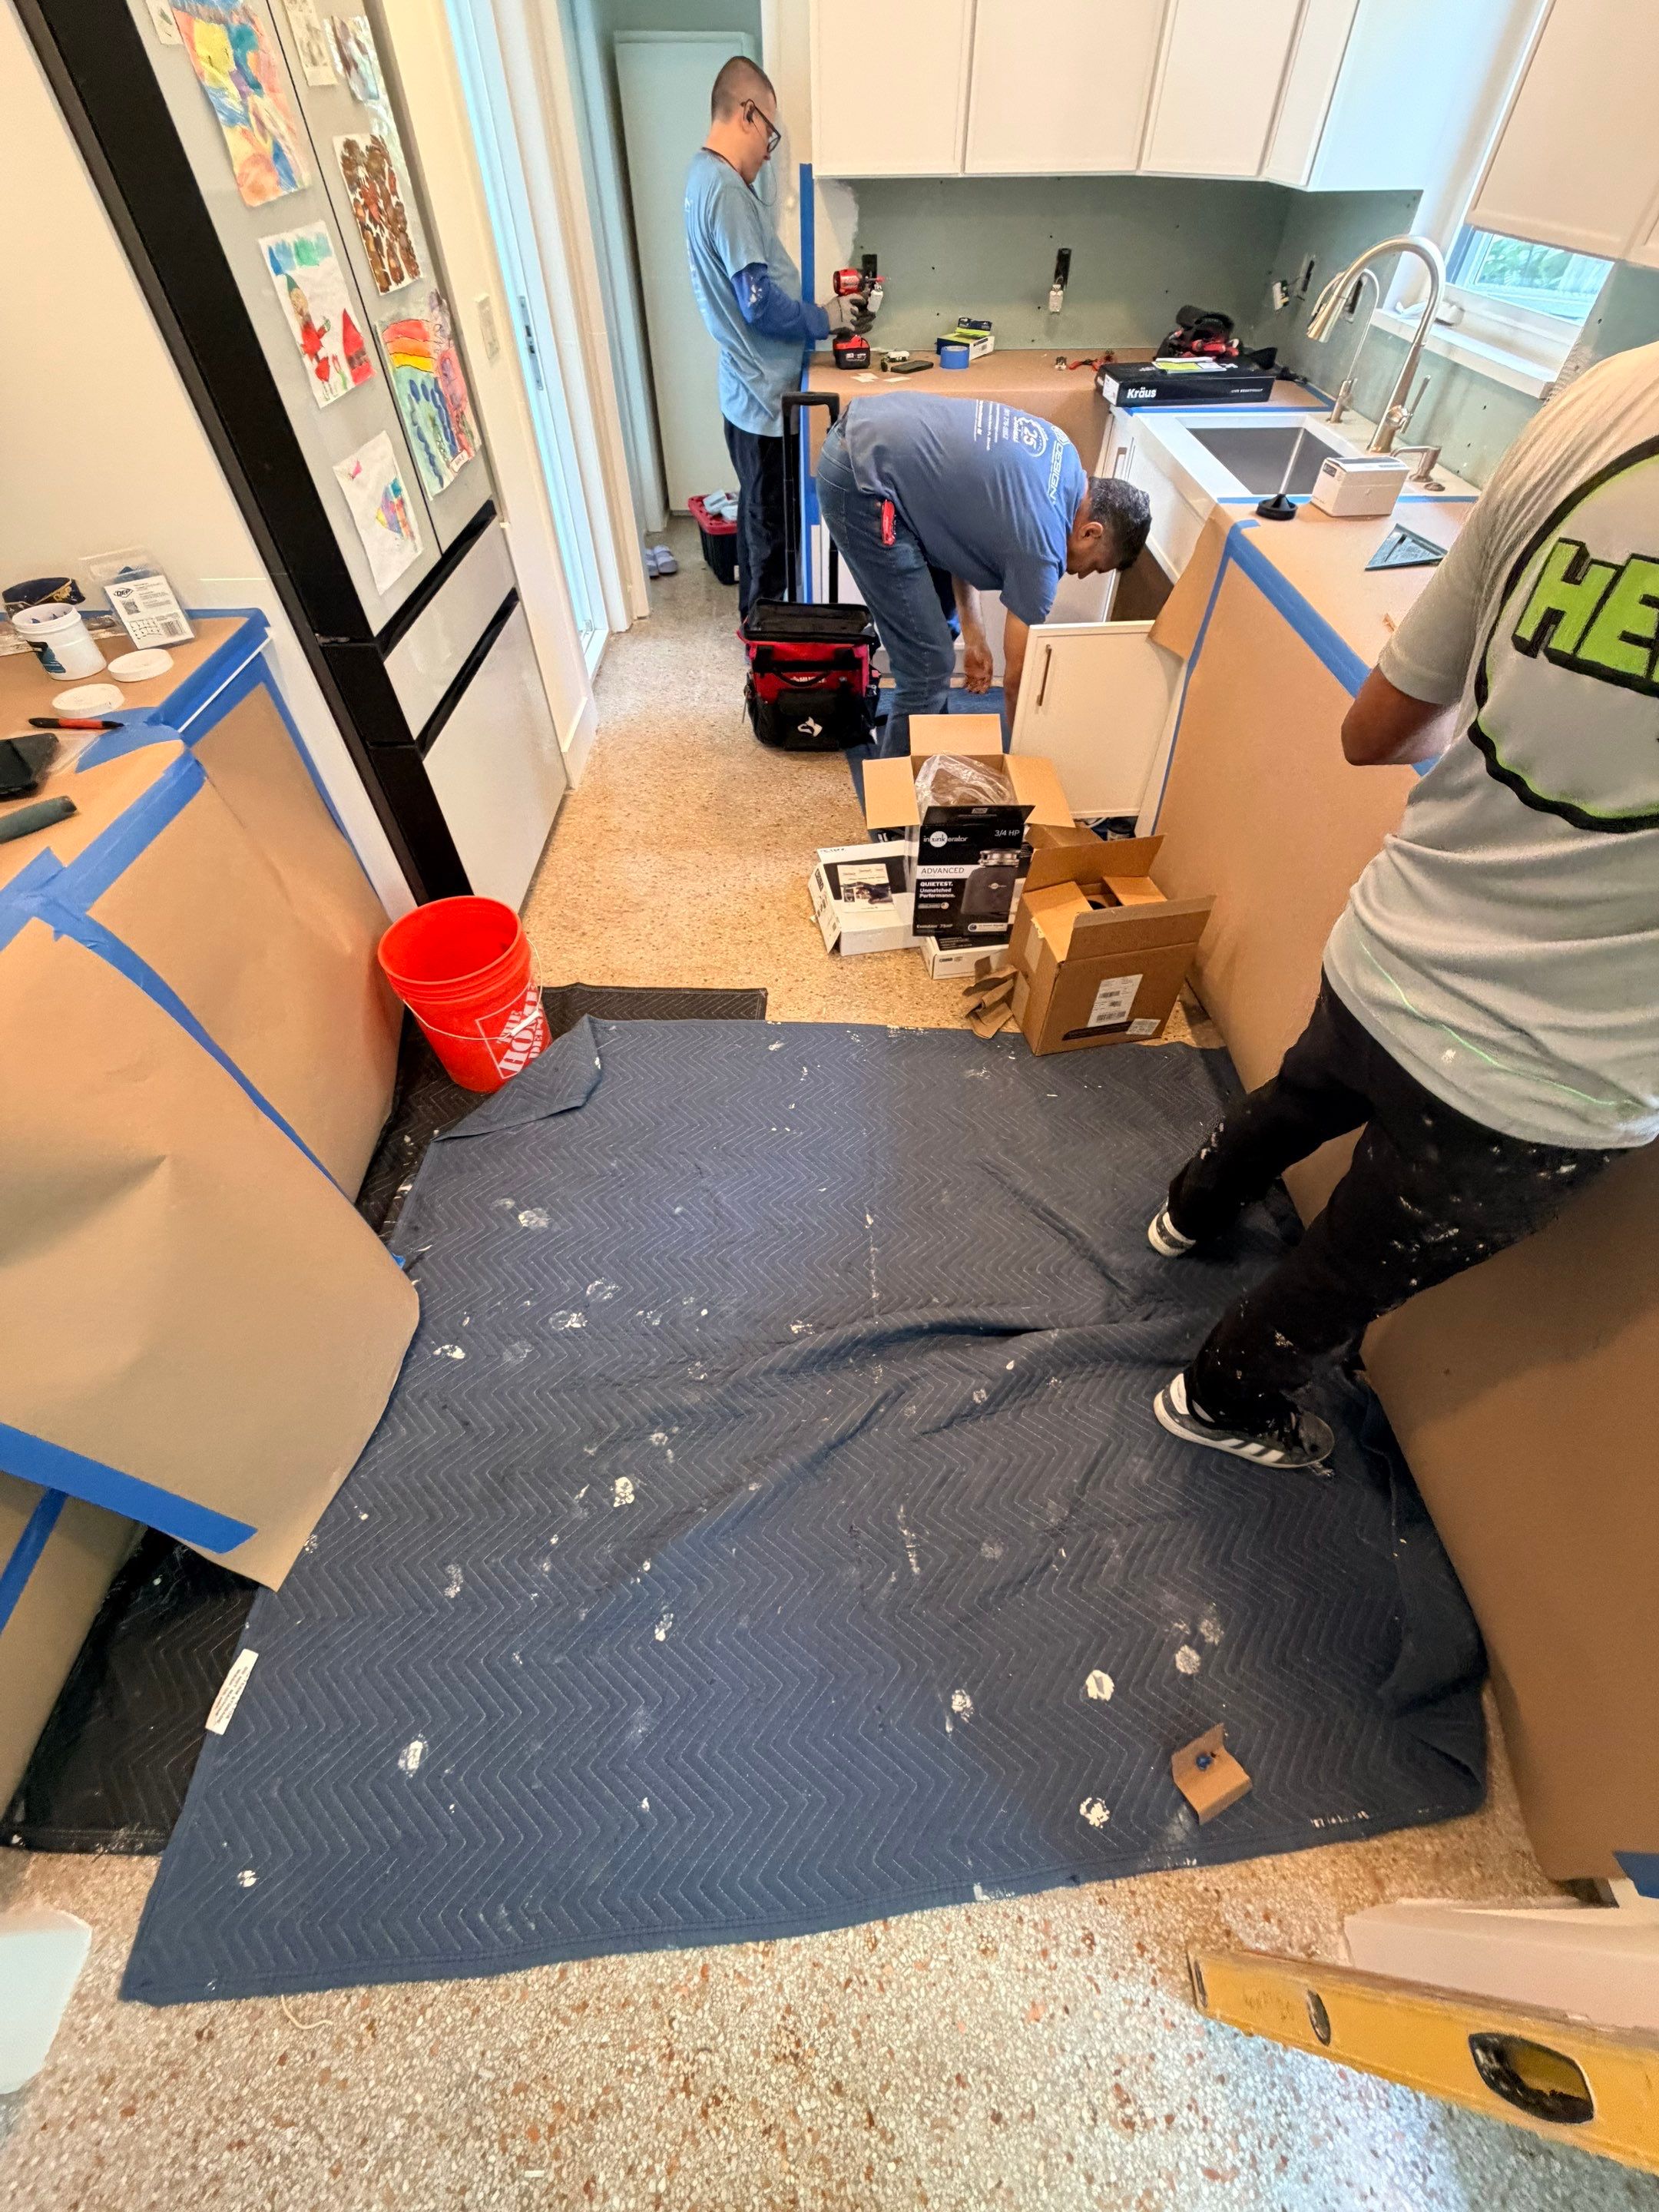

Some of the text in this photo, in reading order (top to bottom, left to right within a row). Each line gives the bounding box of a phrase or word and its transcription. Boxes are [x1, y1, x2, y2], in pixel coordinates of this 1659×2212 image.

[1127, 387, 1157, 399] Kräus
[1023, 429, 1038, 449] 25
[1048, 442, 1064, 502] DESIGN
[1512, 537, 1659, 698] HE
[922, 866, 965, 875] ADVANCED
